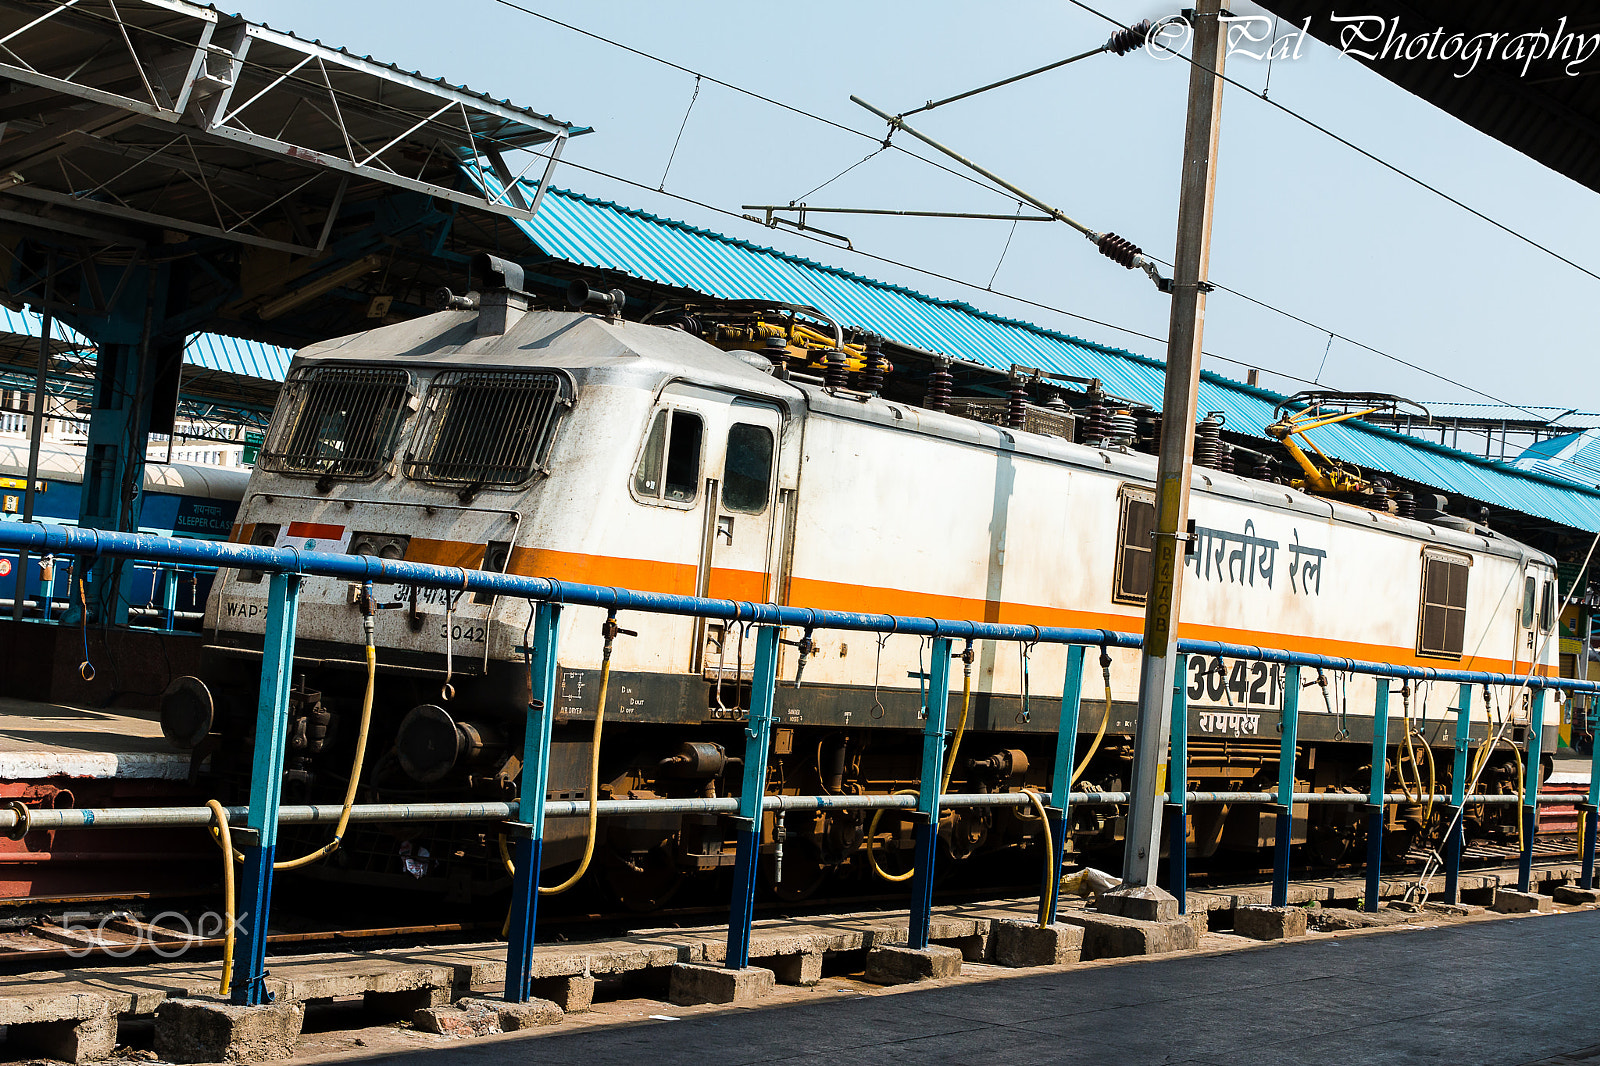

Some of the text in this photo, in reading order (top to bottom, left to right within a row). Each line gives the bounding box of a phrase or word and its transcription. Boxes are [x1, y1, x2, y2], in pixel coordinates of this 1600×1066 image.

[178, 515, 234, 530] SLEEPER CLASS
[1289, 527, 1327, 596] रेल
[1187, 655, 1278, 706] 30421
